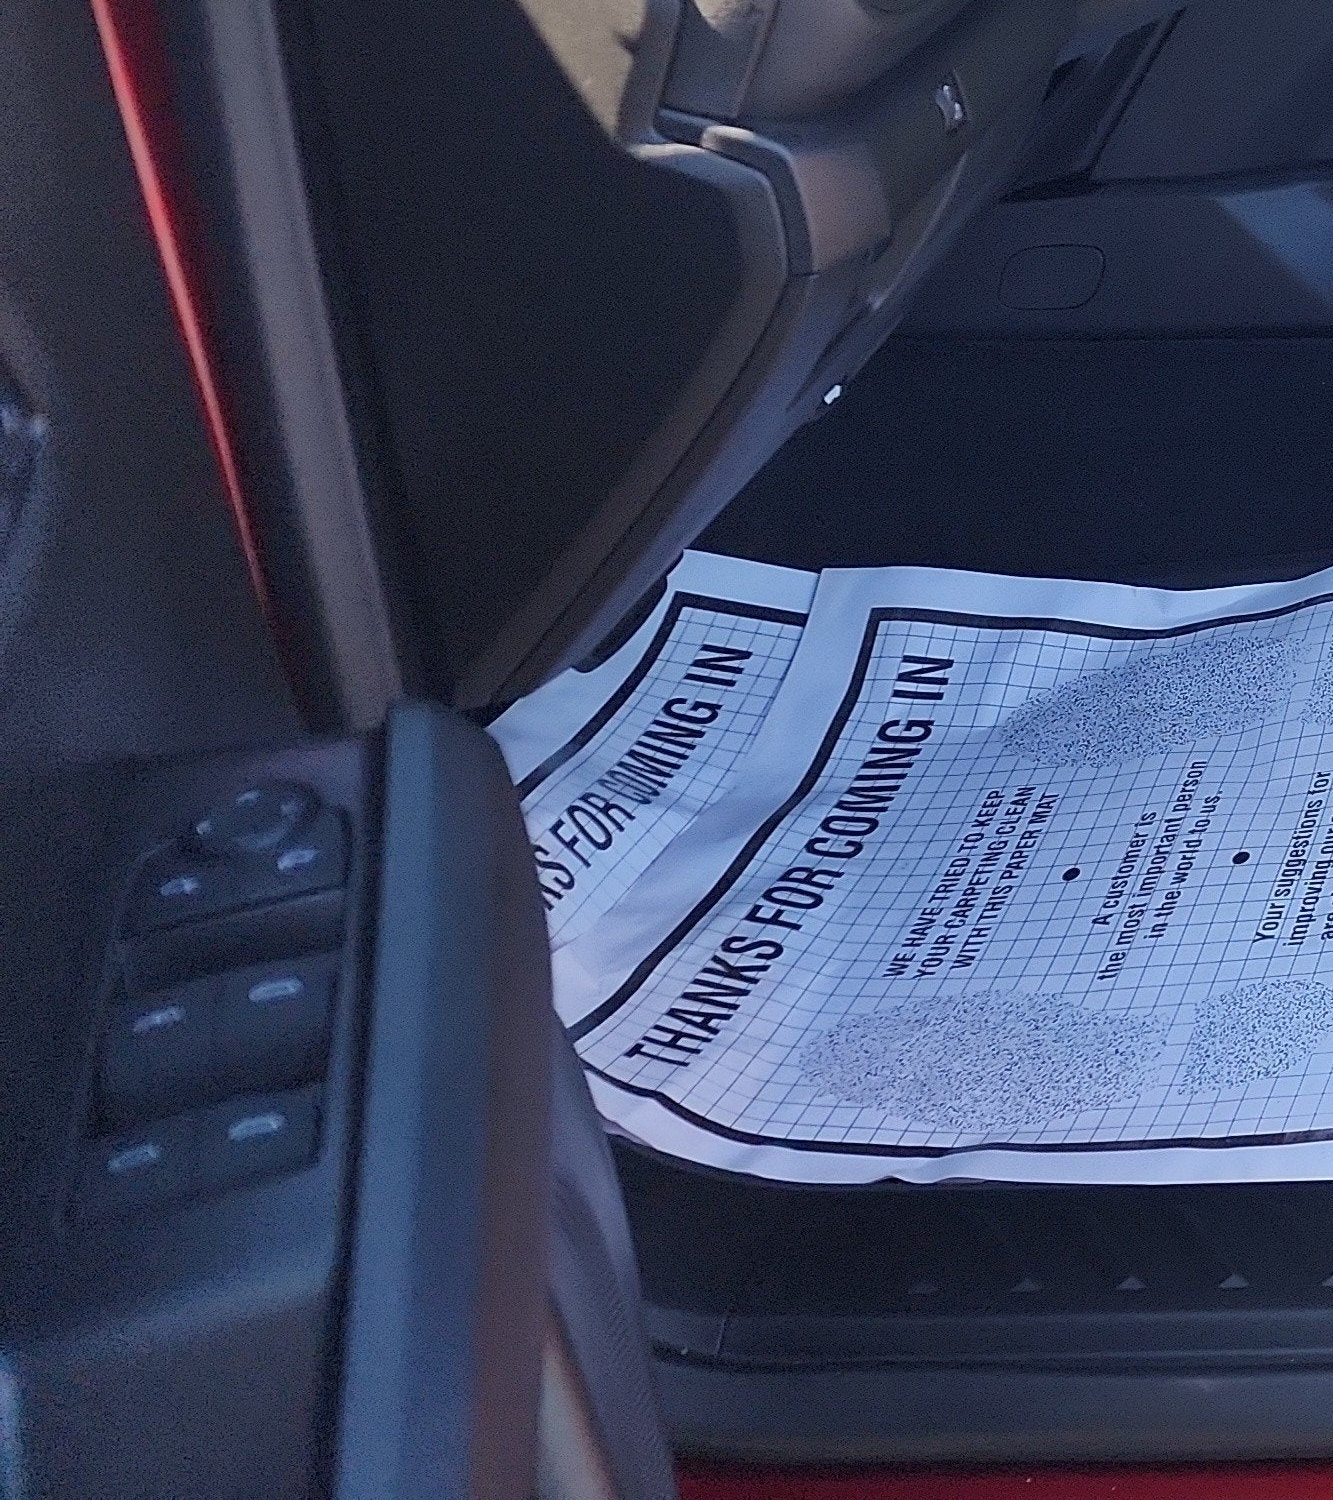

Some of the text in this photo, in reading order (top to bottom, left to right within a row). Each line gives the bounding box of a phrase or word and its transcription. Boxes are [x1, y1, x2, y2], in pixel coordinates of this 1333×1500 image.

[549, 792, 636, 868] FOR
[600, 697, 724, 805] COMING
[683, 644, 753, 687] IN
[624, 655, 954, 1067] THANKS FOR COMING IN
[882, 790, 1006, 978] WE HAVE TRIED TO KEEP
[912, 786, 1037, 979] YOUR CARPETING CLEAN
[949, 792, 1060, 970] WITH THIS PAPER MAT
[1092, 811, 1157, 926] A customer is
[1097, 760, 1208, 980] the most important person
[1143, 789, 1224, 940] in the world to us.
[1252, 771, 1331, 944] Your suggestions for
